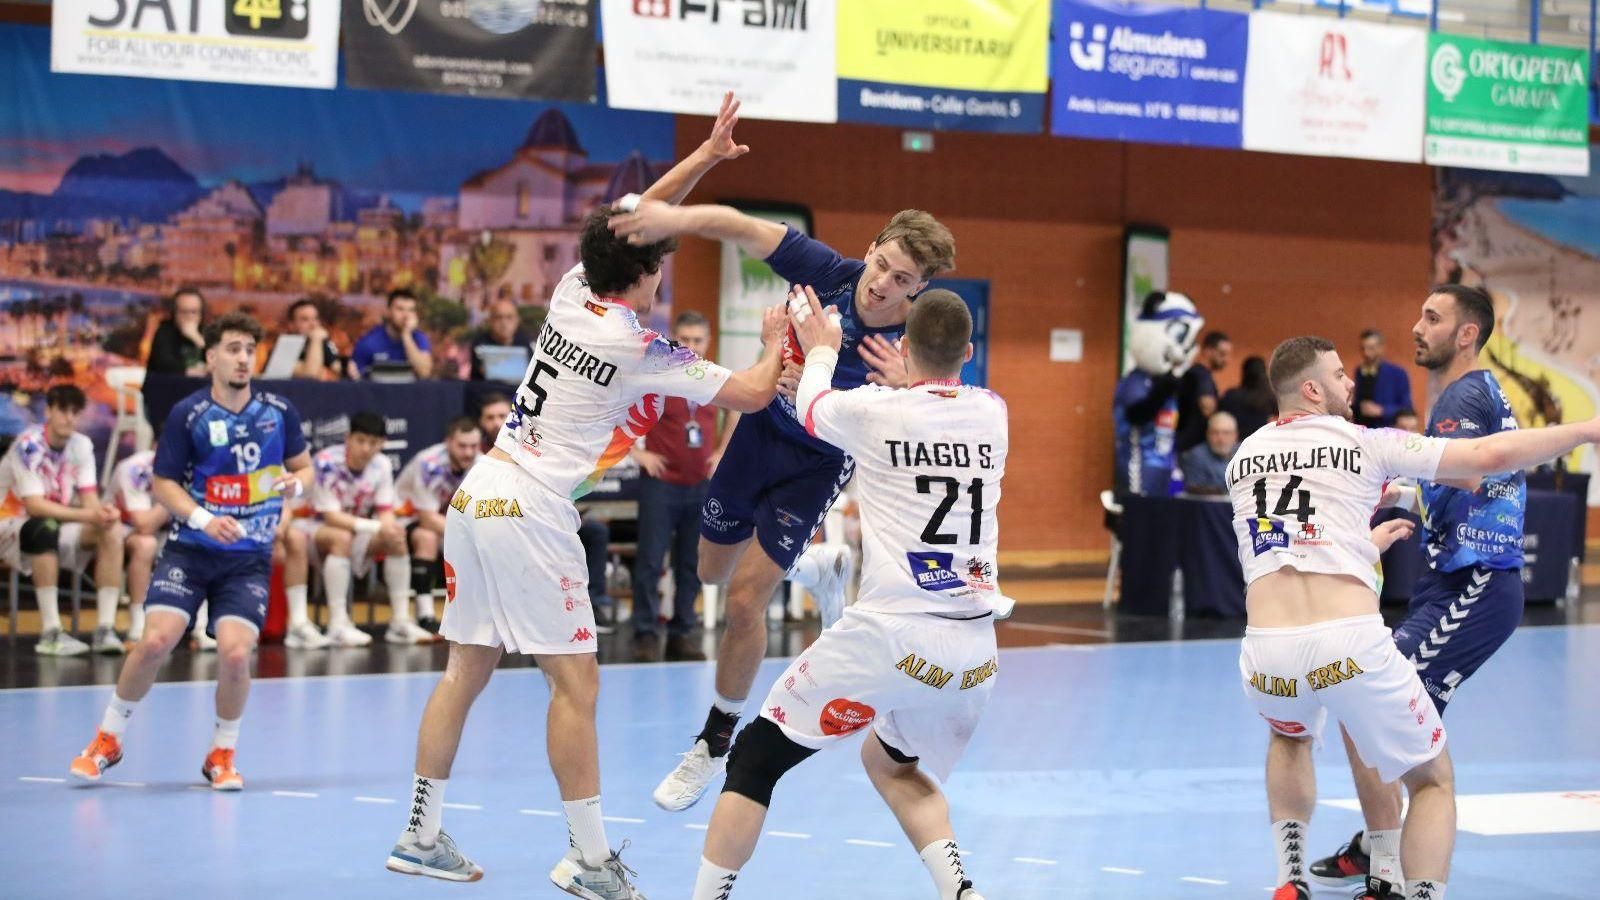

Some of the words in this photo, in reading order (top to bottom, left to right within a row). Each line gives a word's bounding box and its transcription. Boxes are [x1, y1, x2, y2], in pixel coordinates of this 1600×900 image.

[88, 37, 121, 54] FOR
[124, 39, 150, 56] ALL
[151, 41, 196, 60] YOUR
[200, 45, 310, 68] CONNECTIONS
[1109, 26, 1207, 60] Almudena
[1108, 52, 1180, 81] seguros
[520, 359, 559, 418] 5
[230, 442, 261, 474] 19
[885, 440, 971, 468] TIAGO
[979, 444, 995, 469] S.
[212, 481, 241, 500] TM
[1253, 475, 1316, 522] 14
[475, 497, 523, 519] ERKA
[915, 475, 985, 545] 21
[1466, 539, 1505, 554] HOTELES
[895, 653, 954, 690] ALIM
[960, 656, 998, 690] ERKA
[1249, 671, 1298, 698] ALIM
[1306, 657, 1363, 692] ERKA
